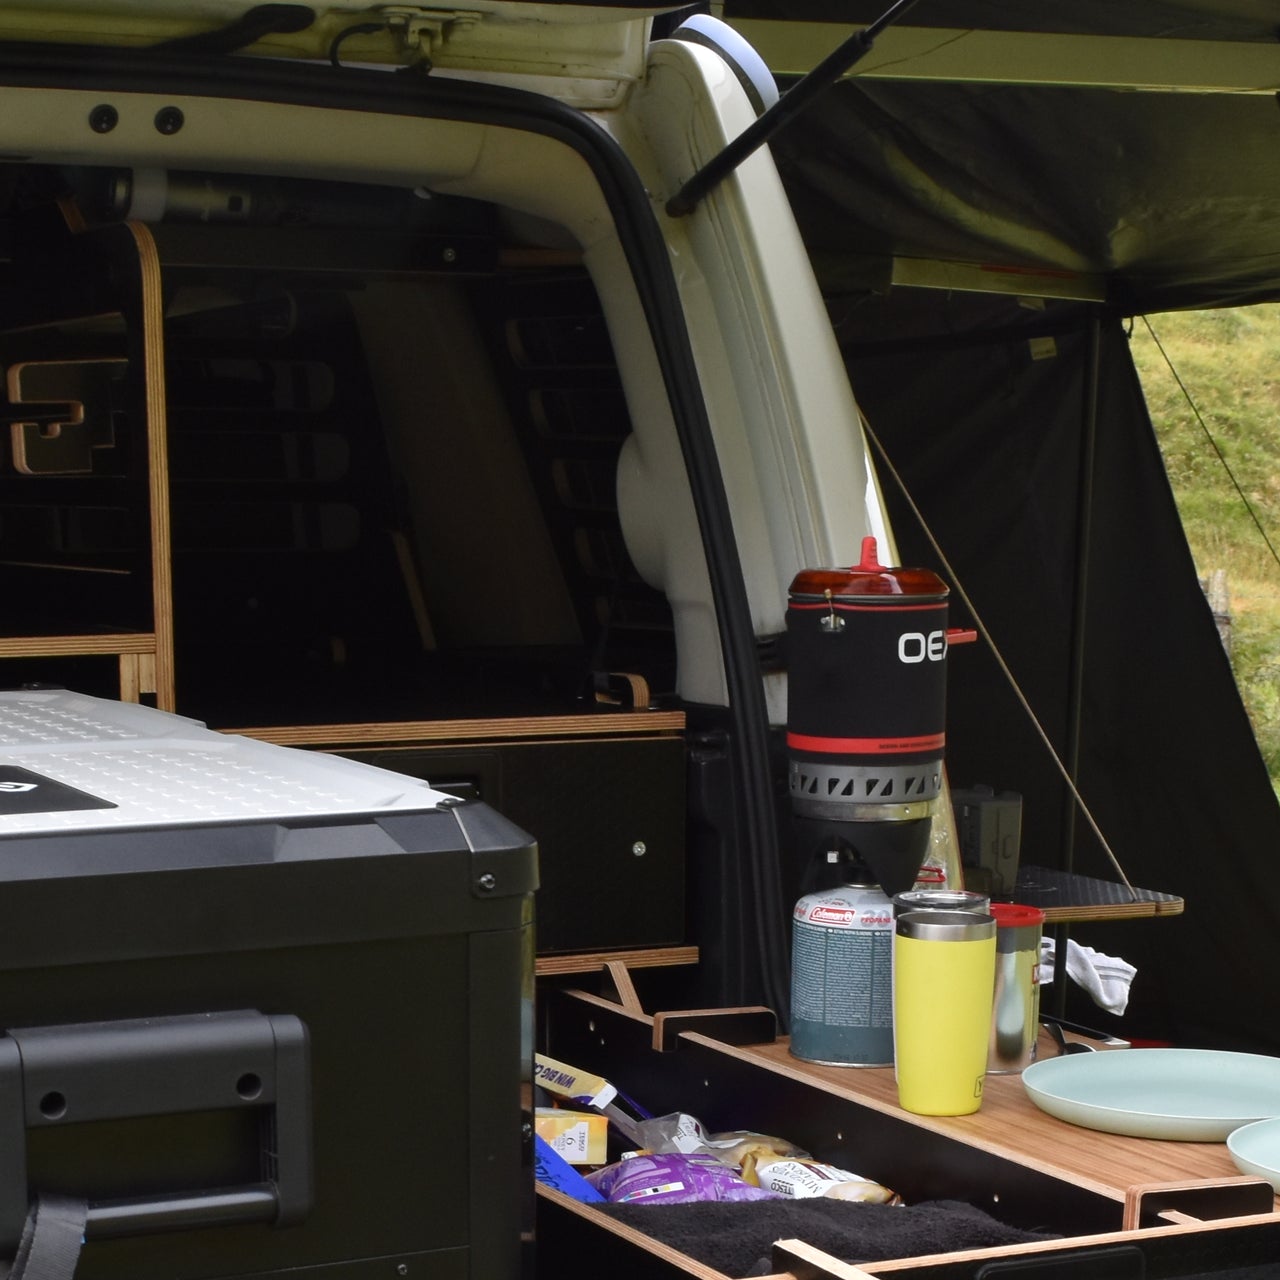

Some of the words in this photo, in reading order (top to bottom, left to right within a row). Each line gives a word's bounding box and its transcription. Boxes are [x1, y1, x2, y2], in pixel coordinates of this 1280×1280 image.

[811, 907, 844, 920] Coleman
[540, 1067, 559, 1082] BIG
[554, 1073, 577, 1089] WIN
[566, 1137, 576, 1146] 6
[770, 1182, 793, 1196] TESCO
